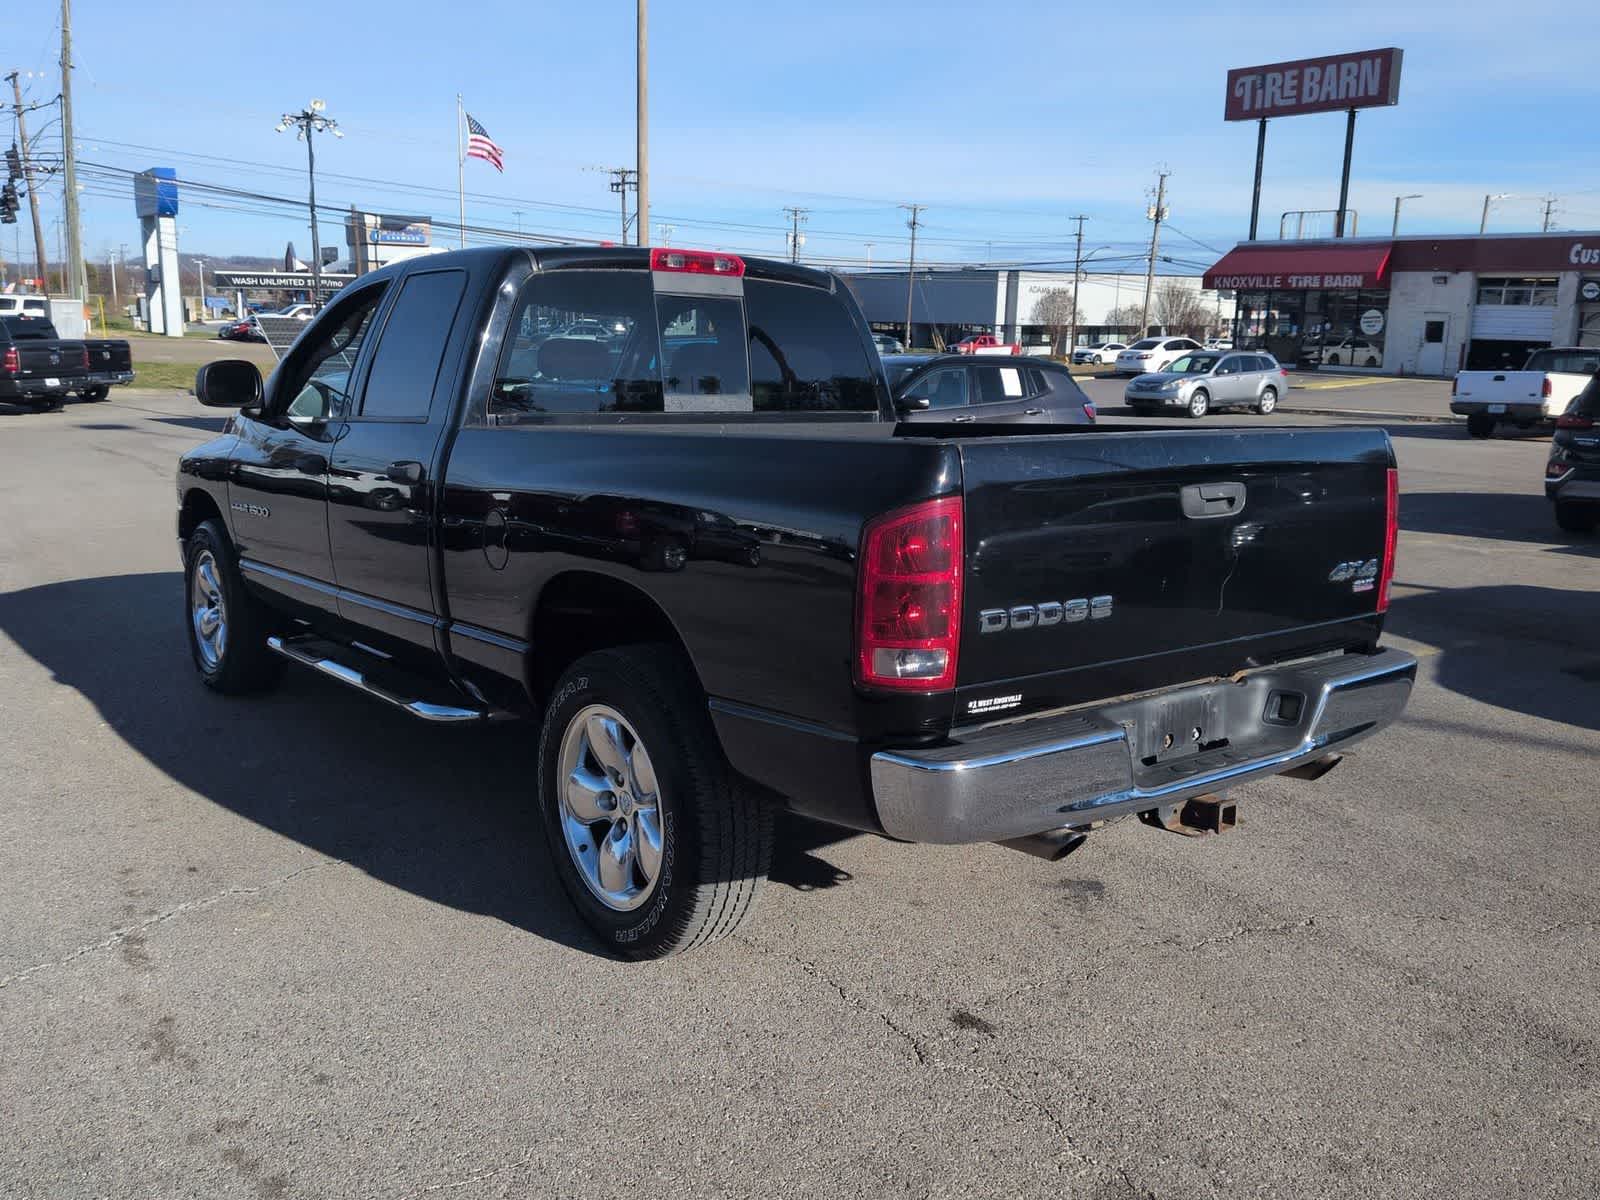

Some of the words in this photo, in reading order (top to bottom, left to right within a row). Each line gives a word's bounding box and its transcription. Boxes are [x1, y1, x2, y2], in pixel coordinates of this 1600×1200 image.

[1302, 57, 1382, 105] BARN
[232, 277, 258, 286] WASH
[260, 278, 305, 287] UNLIMITED
[1214, 275, 1282, 288] KNOXVILLE
[1323, 274, 1363, 288] BARN
[980, 595, 1112, 633] DODGE
